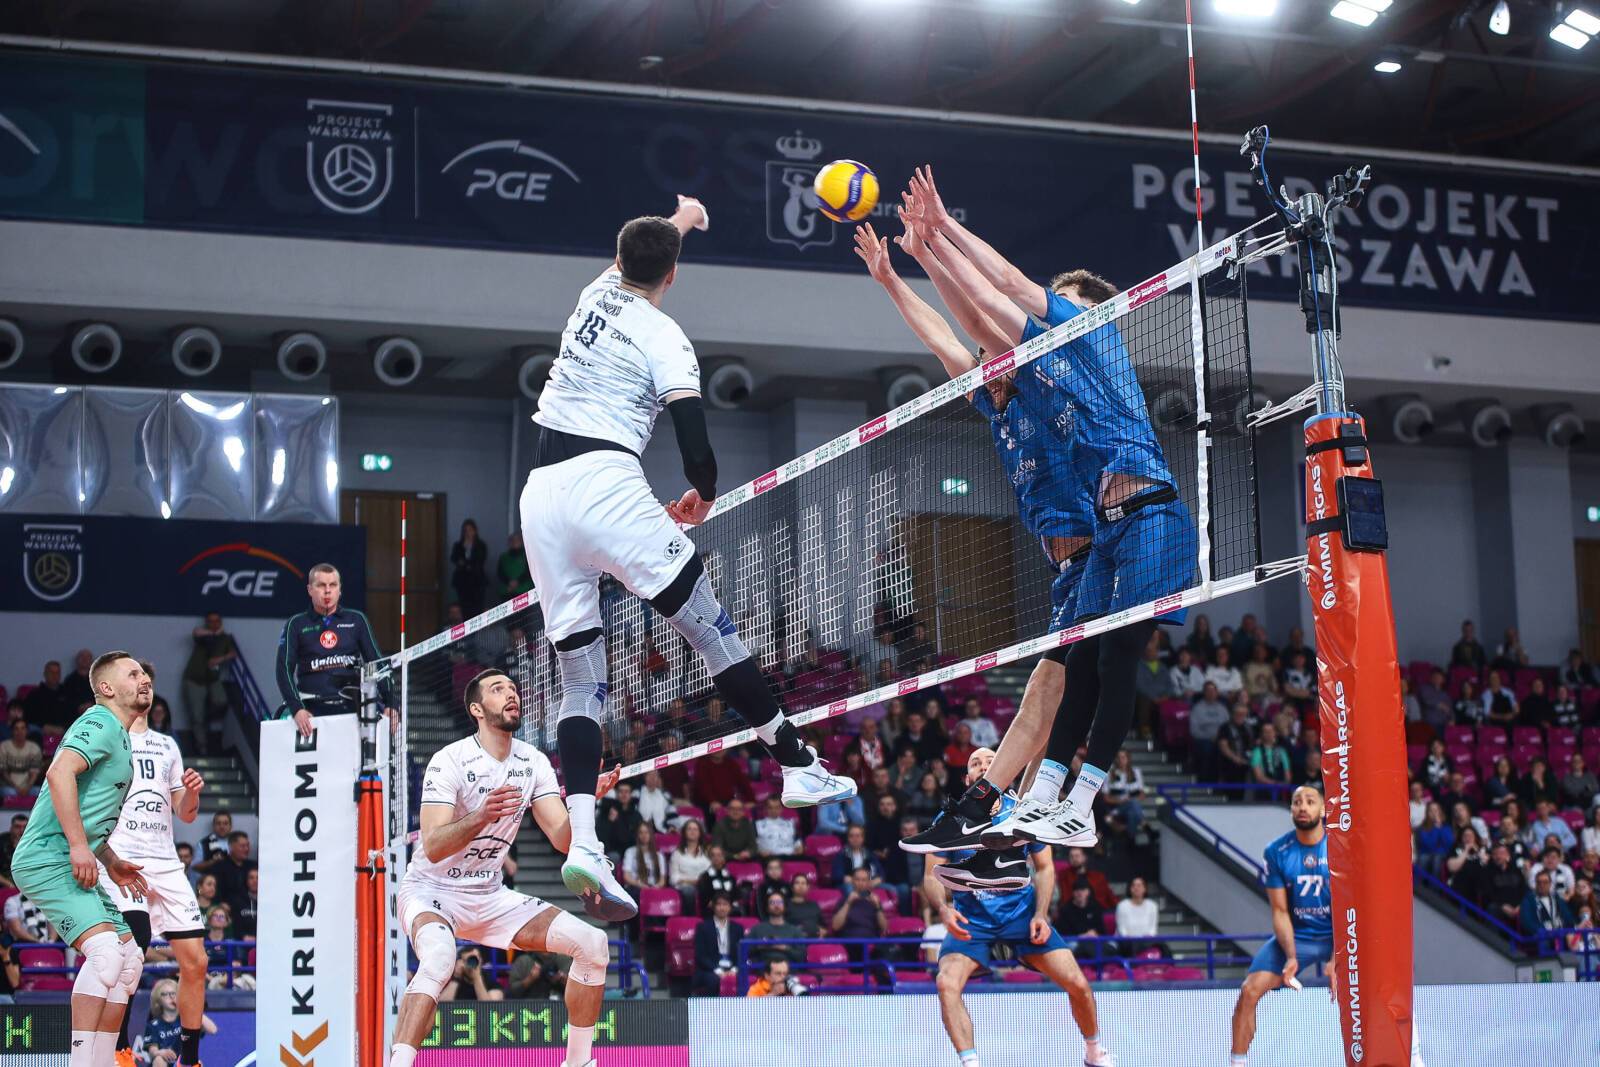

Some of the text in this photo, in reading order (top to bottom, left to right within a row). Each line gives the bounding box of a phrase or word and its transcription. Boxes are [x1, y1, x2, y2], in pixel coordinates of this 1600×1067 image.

[317, 114, 382, 129] PROJEKT
[308, 125, 391, 142] WARSZAWA
[466, 168, 552, 201] PGE
[1132, 164, 1256, 216] PGE
[1167, 223, 1535, 296] WASZAWA
[1214, 244, 1232, 260] netex
[620, 293, 635, 303] liga
[1311, 465, 1335, 589] IMMRGAS
[201, 570, 279, 598] PGE
[1335, 681, 1351, 810] IMMERGAS
[137, 759, 155, 779] 19
[507, 768, 524, 779] plus
[134, 801, 163, 813] PGE
[464, 847, 503, 860] PGE
[291, 727, 318, 1015] KRISHOME
[464, 870, 491, 878] PLAST
[1296, 874, 1323, 897] 77
[1346, 908, 1362, 1040] IMMERGAS
